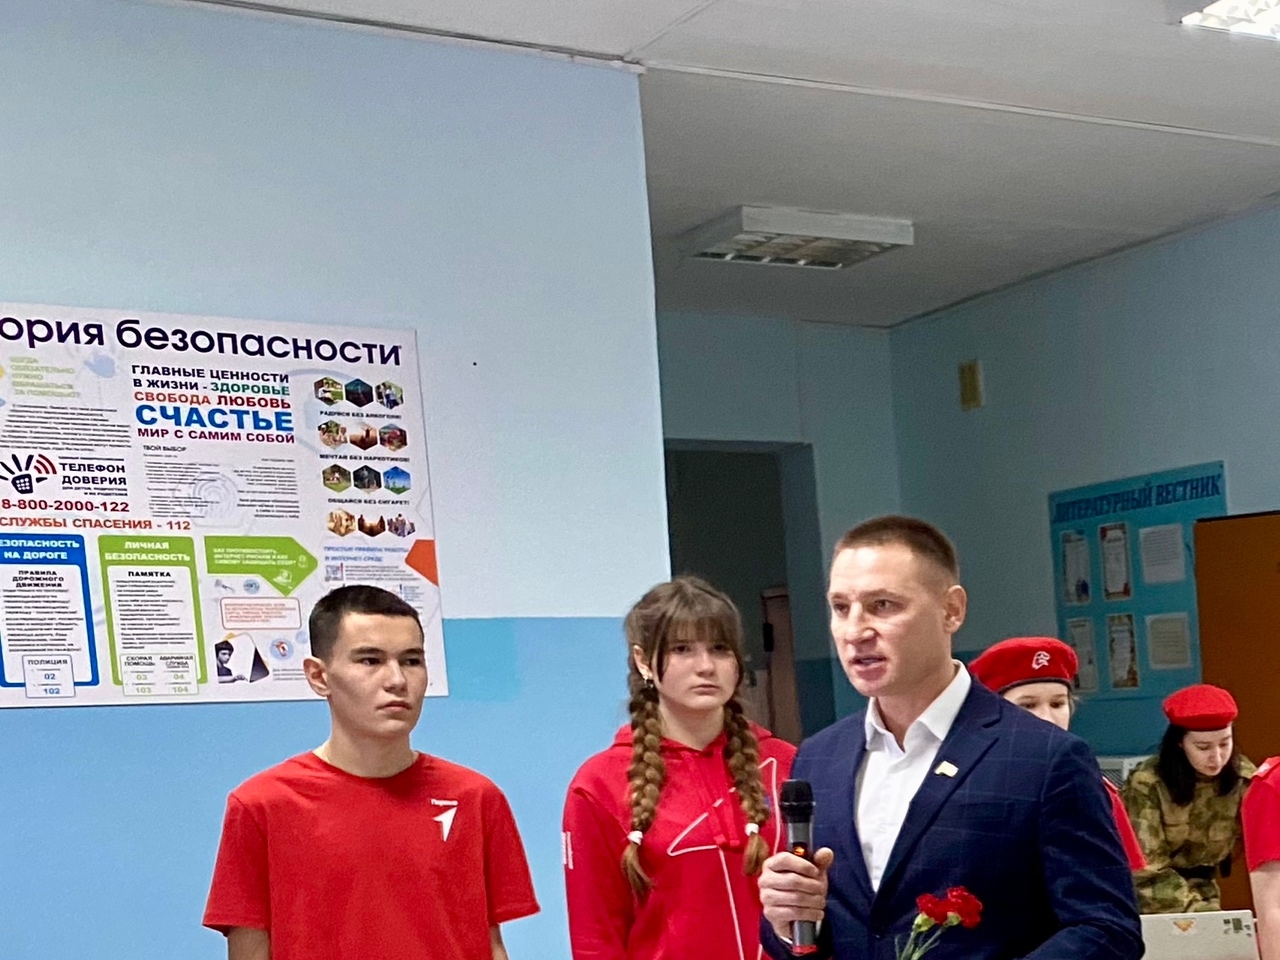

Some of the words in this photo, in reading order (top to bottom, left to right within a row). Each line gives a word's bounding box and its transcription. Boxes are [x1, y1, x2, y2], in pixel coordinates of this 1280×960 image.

[0, 317, 105, 348] ория
[116, 319, 402, 366] безопасности
[131, 365, 206, 378] ГЛАВНЫЕ
[210, 369, 289, 383] ЦЕННОСТИ
[133, 378, 143, 388] В
[147, 379, 199, 391] ЖИЗНИ
[210, 382, 290, 396] ЗДОРОВЬЕ
[134, 391, 211, 405] СВОБОДА
[217, 395, 291, 409] ЛЮБОВЬ
[135, 404, 294, 431] СЧАСТЬЕ
[137, 428, 169, 438] МИР
[174, 429, 184, 439] С
[188, 430, 242, 441] САМИМ
[246, 432, 295, 444] СОБОЙ
[59, 462, 126, 473] ТЕЛЕФОН
[62, 475, 127, 485] ДОВЕРИЯ
[2, 498, 130, 512] 8-800-2000-122
[1053, 482, 1153, 523] ЛИТЕРАТУРНЫЙ
[1155, 474, 1222, 506] ВЕСТНИК
[0, 517, 67, 527] СЛУЖБЫ
[73, 518, 152, 529] СПАСЕНИЯ
[166, 520, 191, 530] 112
[124, 541, 169, 549] ЛИЧНАЯ
[23, 551, 68, 560] ДОРОГЕ
[104, 552, 191, 561] БЕЗОПАСНОСТЬ
